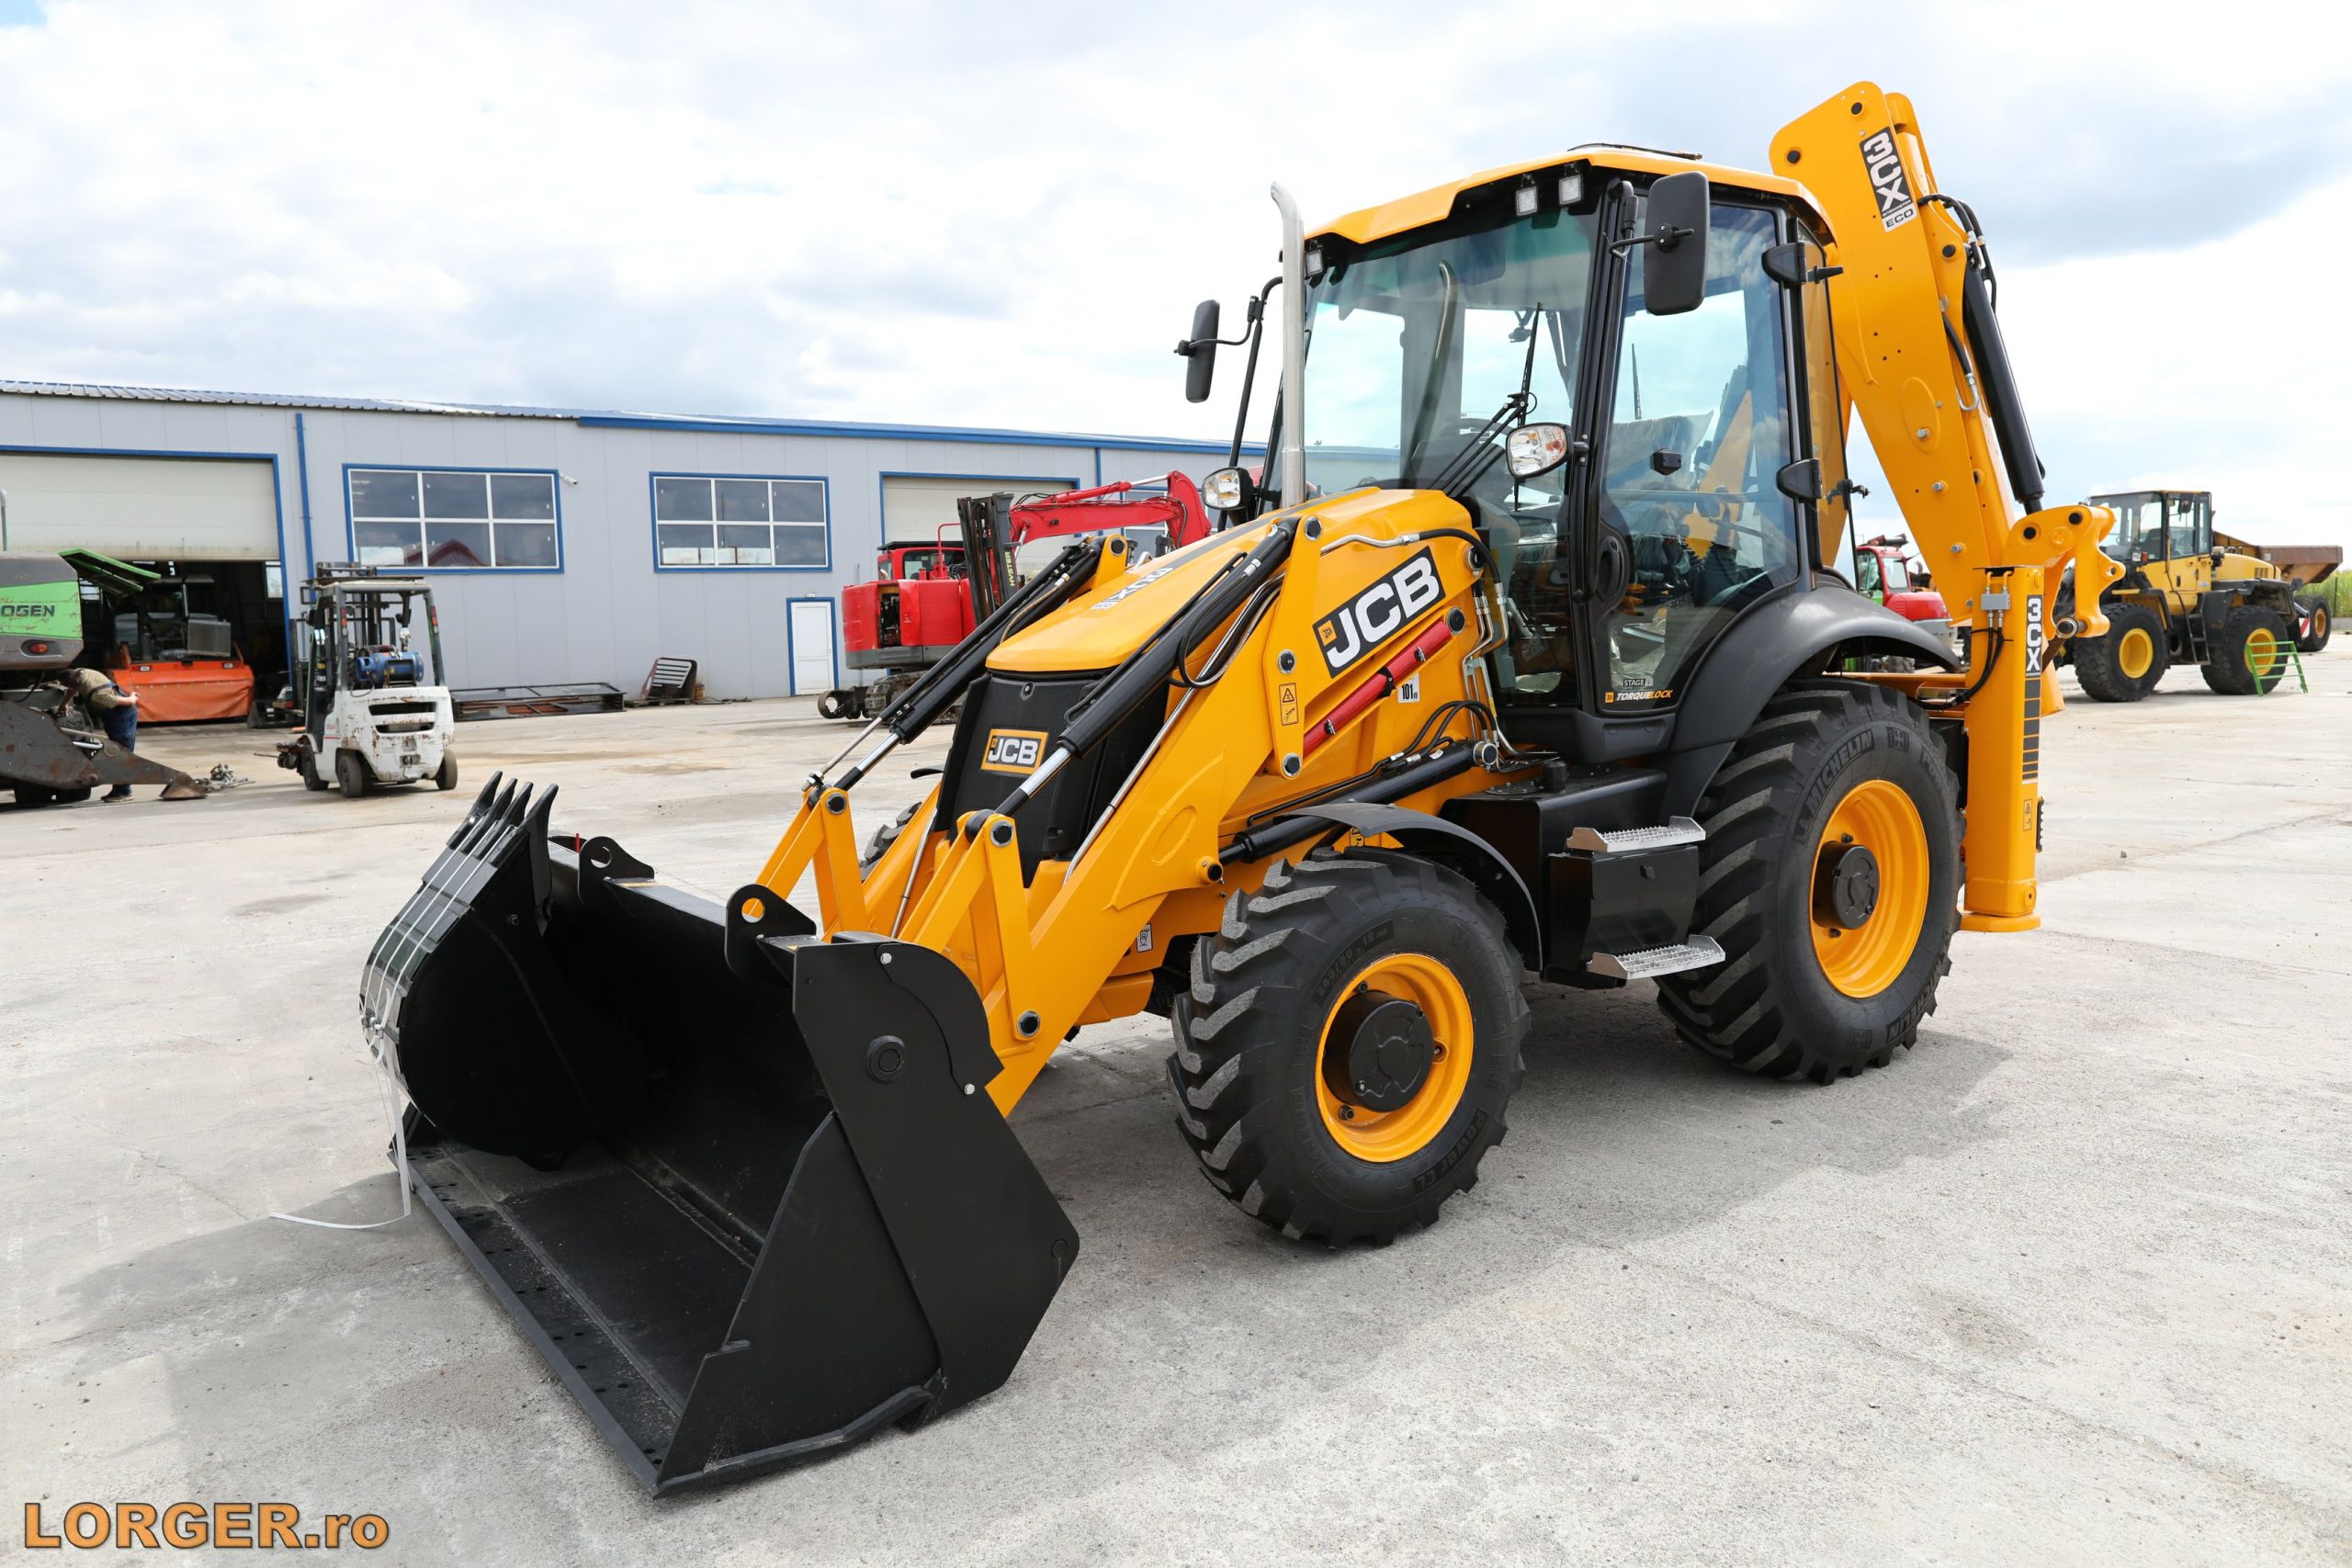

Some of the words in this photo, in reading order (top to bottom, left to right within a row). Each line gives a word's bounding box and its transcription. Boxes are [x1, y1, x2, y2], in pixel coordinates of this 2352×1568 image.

[1863, 132, 1909, 212] 3CX
[1886, 209, 1914, 228] ECO
[1004, 551, 1015, 587] HYSTER
[1, 604, 55, 616] OGEN
[1327, 557, 1440, 668] JCB
[2026, 598, 2041, 671] 3CX
[1402, 682, 1413, 699] 101
[1617, 690, 1673, 701] TORQUELOCK
[1623, 679, 1645, 687] STAGE
[988, 738, 1038, 765] JCB
[1805, 731, 1874, 814] MICHELIN
